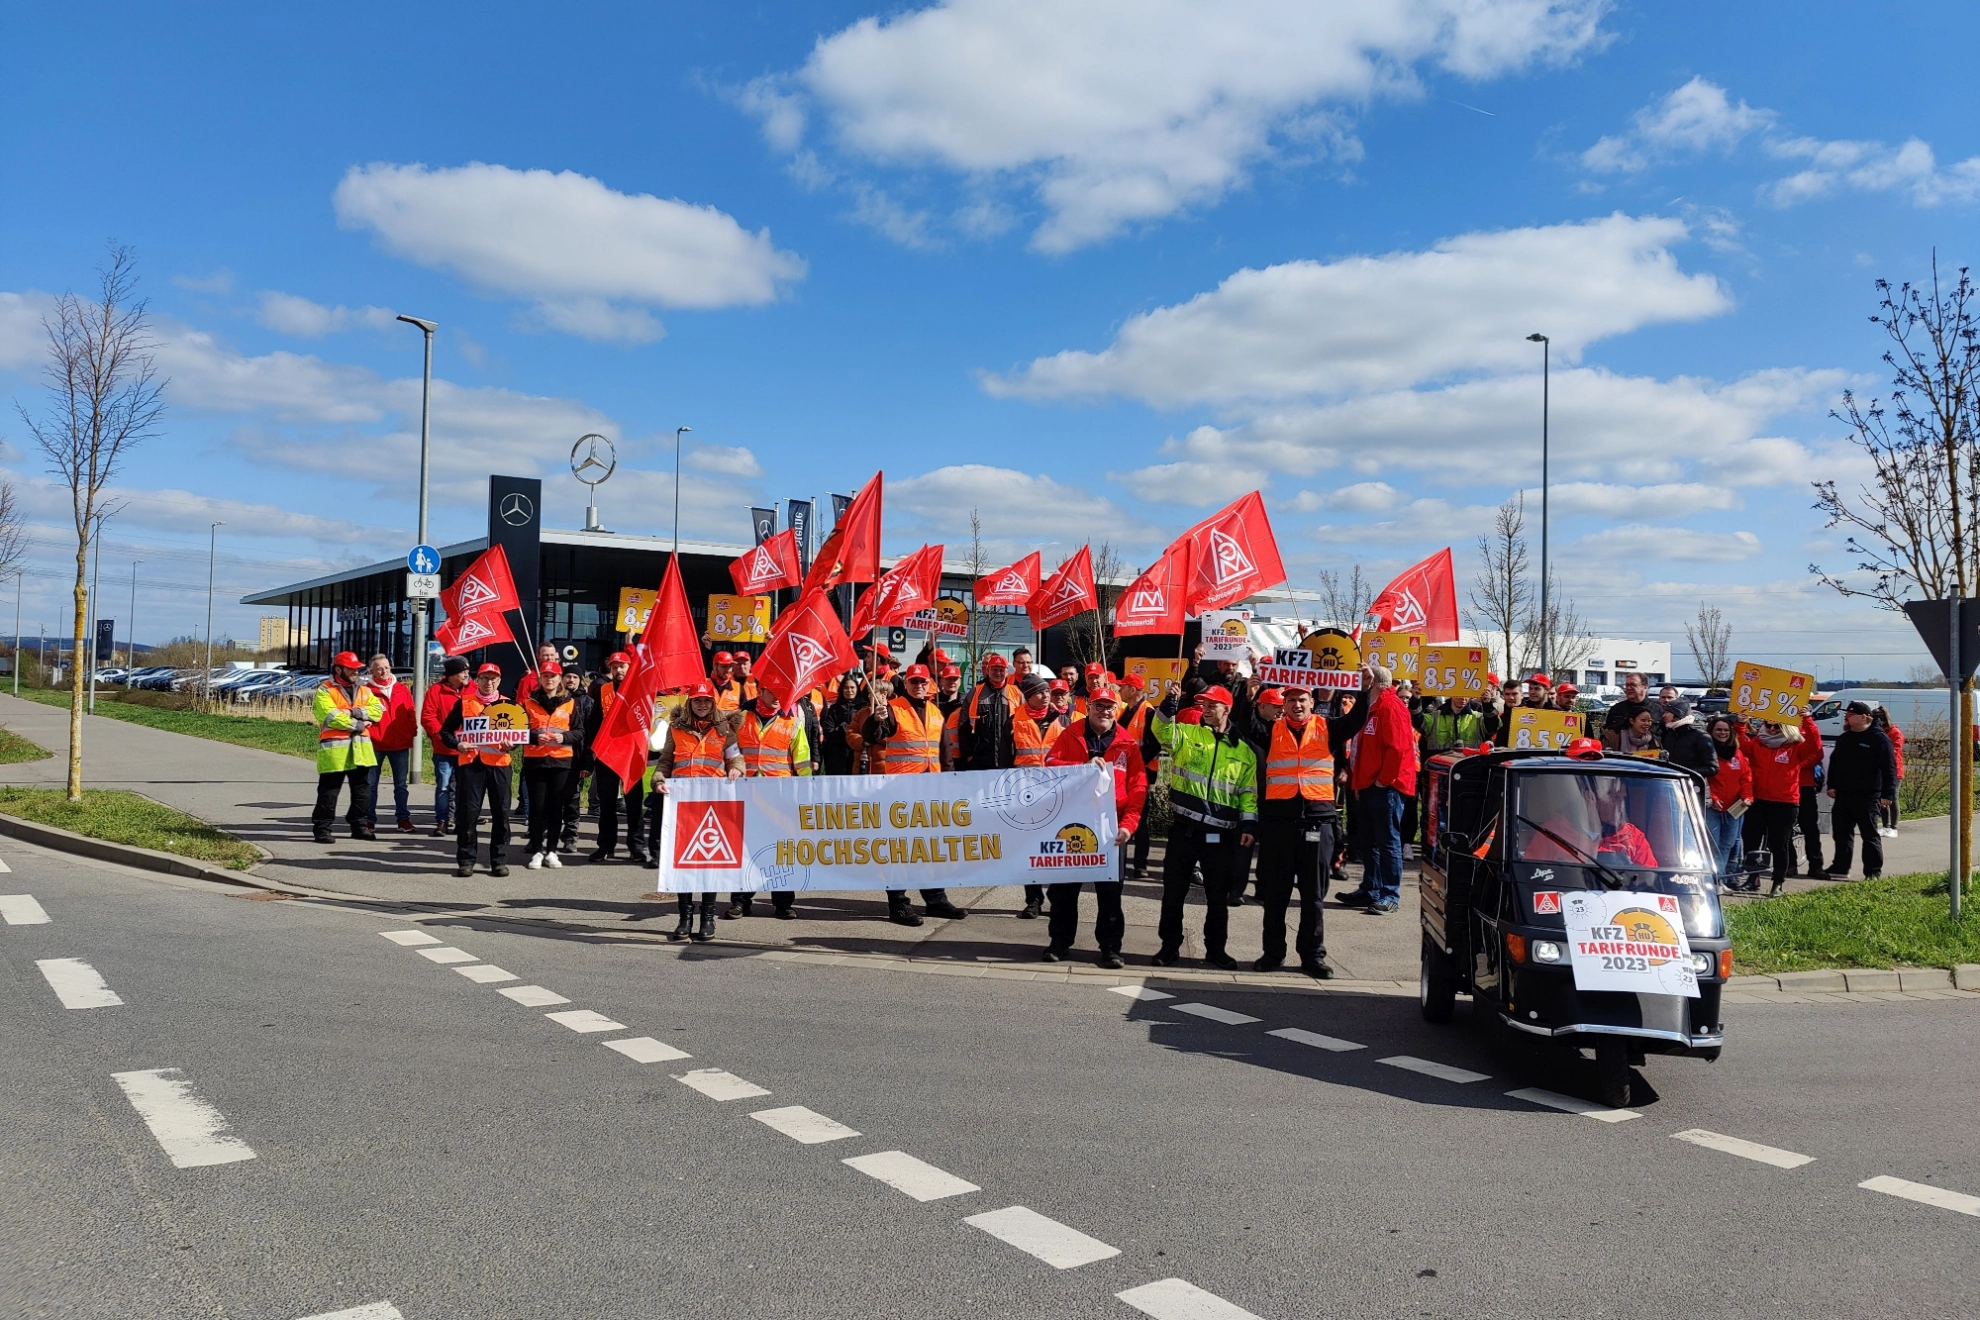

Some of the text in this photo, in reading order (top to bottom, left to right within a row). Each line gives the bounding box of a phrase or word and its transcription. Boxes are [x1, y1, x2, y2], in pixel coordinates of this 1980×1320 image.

[715, 613, 765, 636] 8,5 %
[905, 619, 967, 636] TARIFRUNDE
[1213, 643, 1232, 651] 2023
[1275, 649, 1309, 668] KFZ
[1323, 658, 1335, 667] HU
[1367, 652, 1398, 682] 85
[1259, 667, 1360, 688] TARIFRUNDE
[1424, 666, 1482, 702] 8,5 %
[1737, 684, 1799, 717] 8,5 %
[465, 718, 487, 732] KFZ
[456, 731, 528, 744] TARIFRUNDE
[798, 798, 972, 832] EINEN GANG
[775, 833, 1002, 867] HOCHSCHALTEN
[1040, 841, 1064, 854] KFZ
[1029, 854, 1106, 868] TARIFRUNDE
[1575, 906, 1585, 914] 23
[1591, 926, 1625, 941] KFZ
[1638, 932, 1651, 940] HU
[1577, 942, 1681, 959] TARIFRUNDE
[1601, 956, 1648, 972] 2023
[1682, 974, 1693, 983] 23
